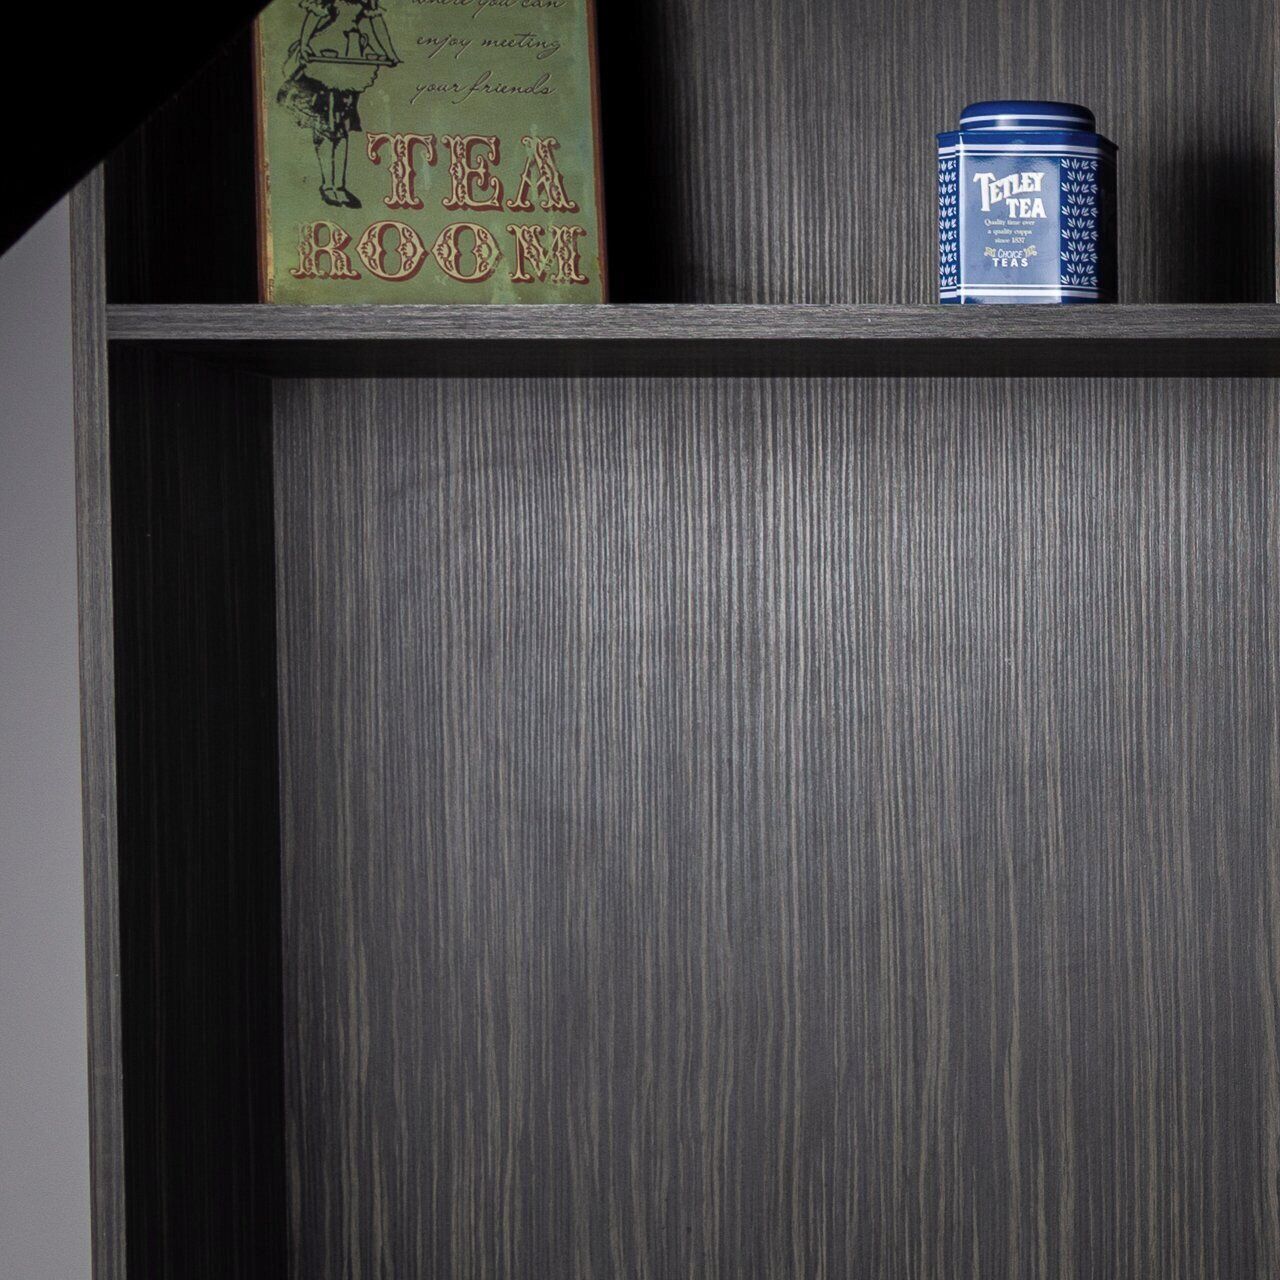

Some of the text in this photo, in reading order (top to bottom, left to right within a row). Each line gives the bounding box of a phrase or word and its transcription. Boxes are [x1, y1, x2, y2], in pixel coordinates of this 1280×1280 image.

[416, 31, 561, 60] enjoy meeting
[409, 70, 557, 105] your friends
[366, 132, 580, 213] TEA
[1006, 197, 1047, 218] TEA
[289, 220, 590, 285] ROOM
[992, 257, 1029, 268] TEAS
